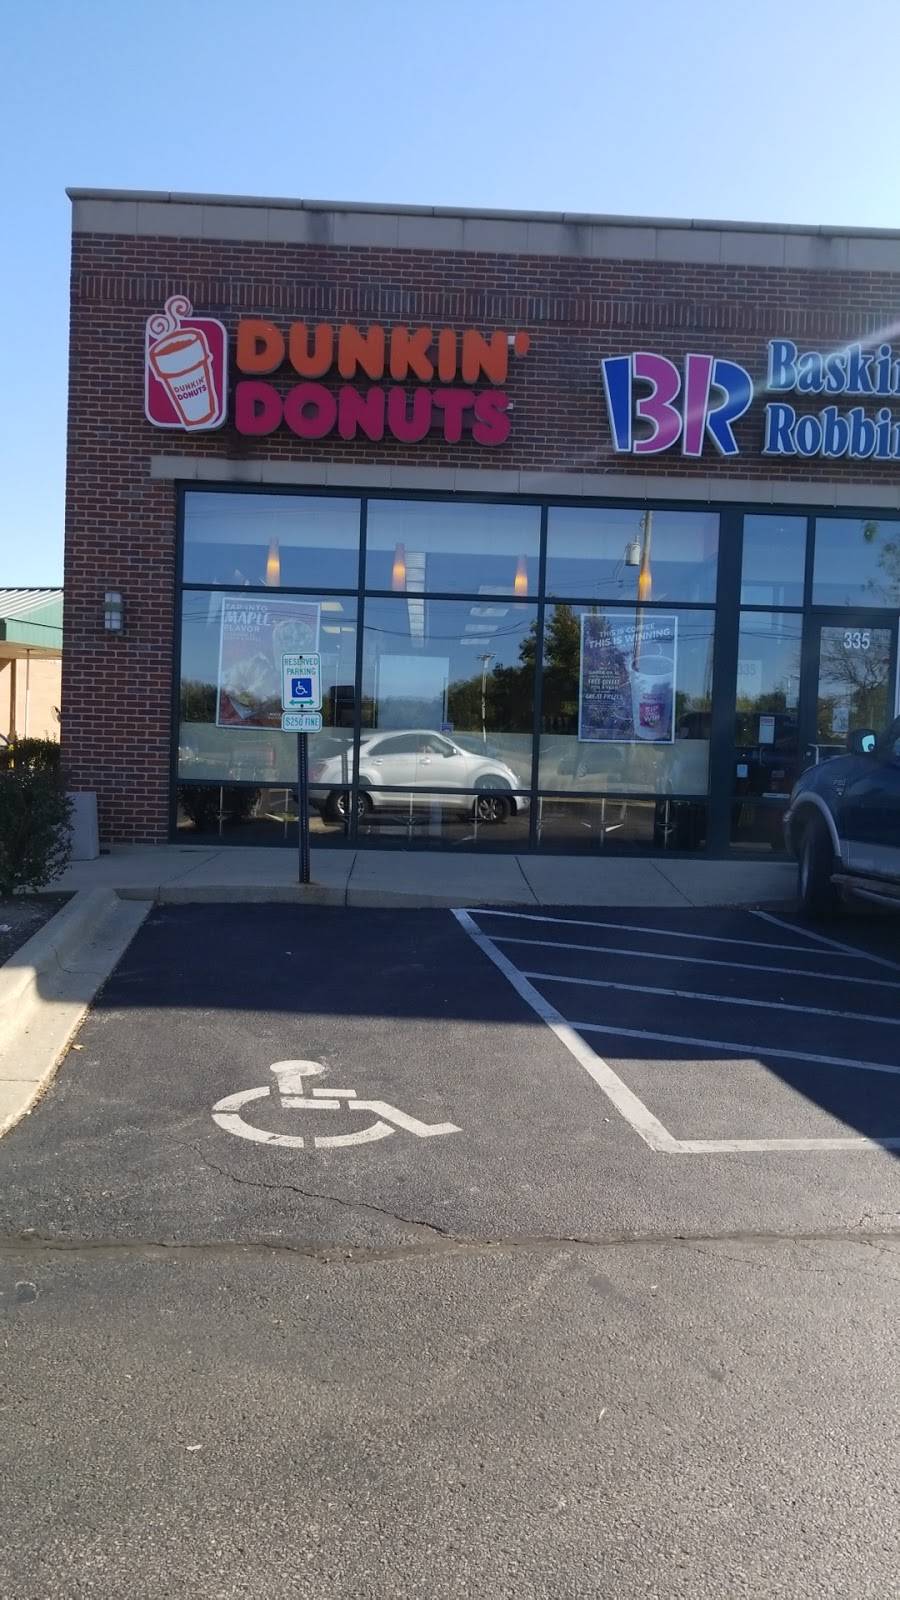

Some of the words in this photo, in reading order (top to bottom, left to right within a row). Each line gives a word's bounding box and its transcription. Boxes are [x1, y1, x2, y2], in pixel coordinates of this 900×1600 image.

[236, 319, 531, 386] DUNKIN'
[766, 339, 900, 395] Baski
[177, 384, 207, 401] DONUTS
[235, 381, 511, 447] DONUTS
[762, 403, 900, 460] Robbi
[224, 611, 272, 626] MAPLE
[589, 638, 611, 648] THIS
[613, 636, 622, 645] IS
[843, 632, 870, 649] 335
[284, 658, 318, 666] RESERVED
[286, 668, 316, 676] PARKING
[285, 717, 303, 727] $250
